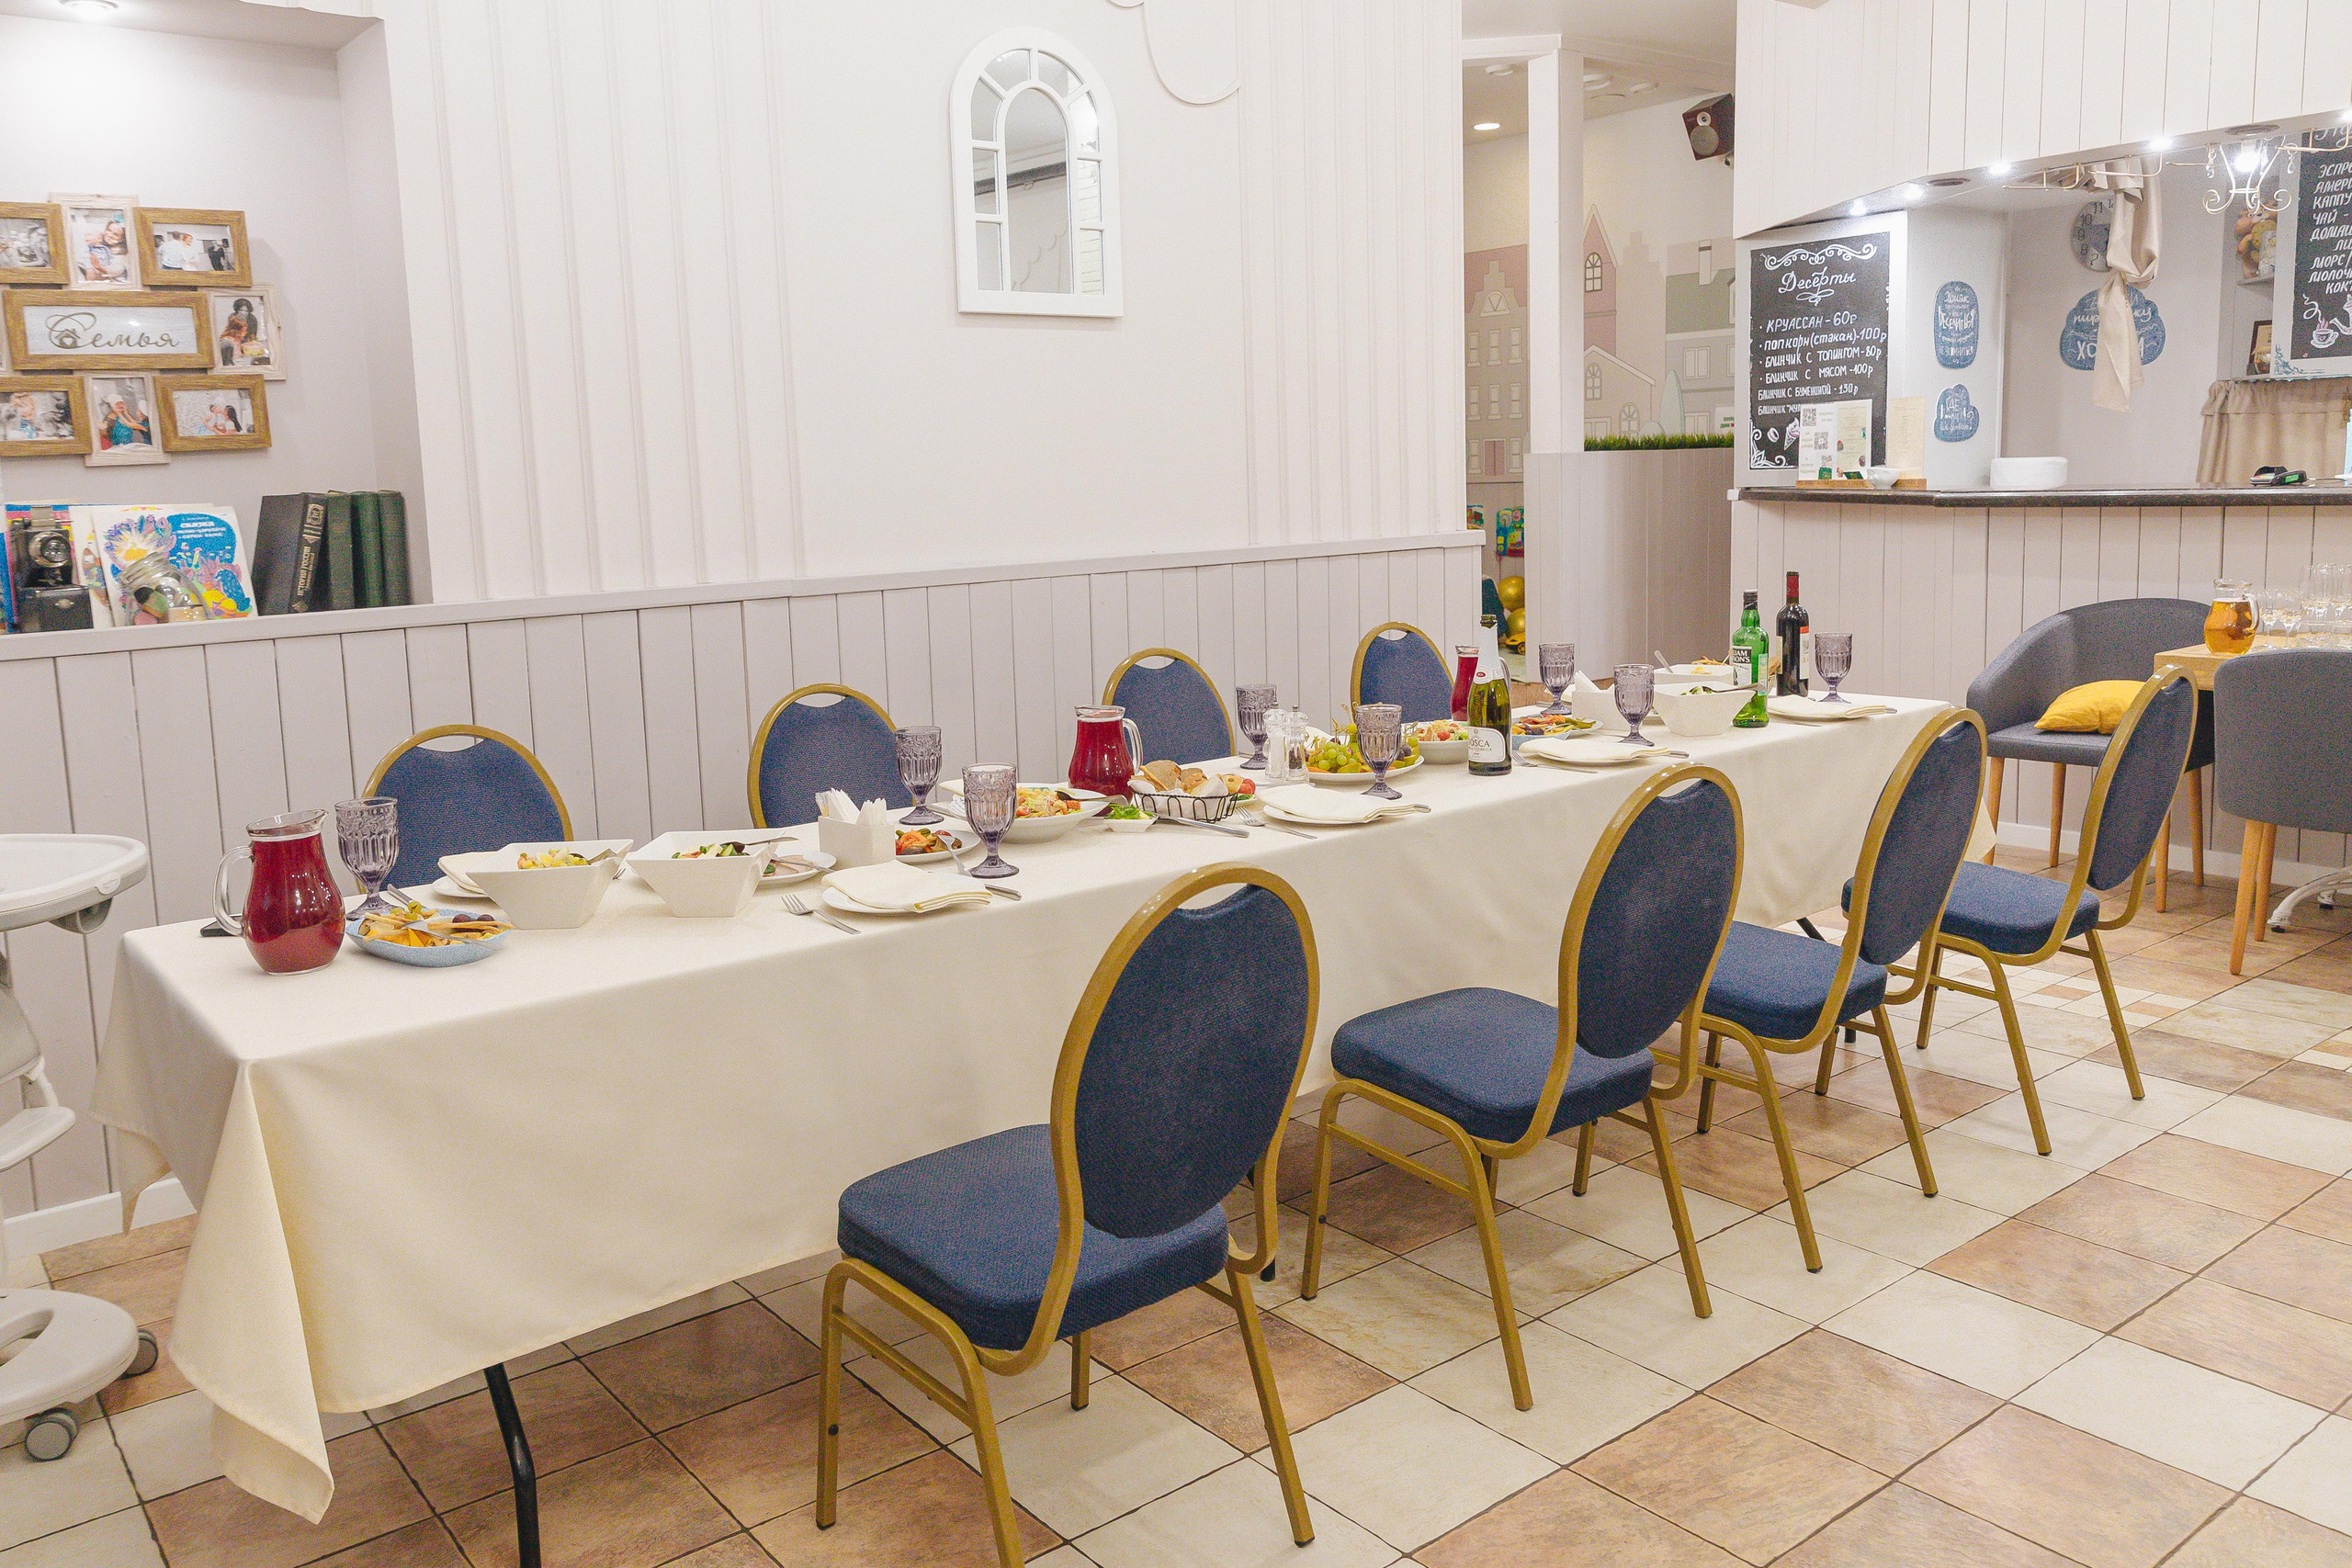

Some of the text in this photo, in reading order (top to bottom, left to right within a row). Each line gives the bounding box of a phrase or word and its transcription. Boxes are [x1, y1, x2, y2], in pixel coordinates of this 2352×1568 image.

[2094, 201, 2103, 214] 11
[2080, 214, 2093, 226] 10
[2312, 209, 2338, 225] ЧАЙ
[2077, 229, 2086, 242] 9
[2080, 243, 2088, 256] 8
[1778, 266, 1857, 297] Десерты
[44, 311, 180, 349] Семья
[1765, 353, 1802, 367] БЛИНЧИК
[1765, 370, 1799, 384] БЛИНЧИК
